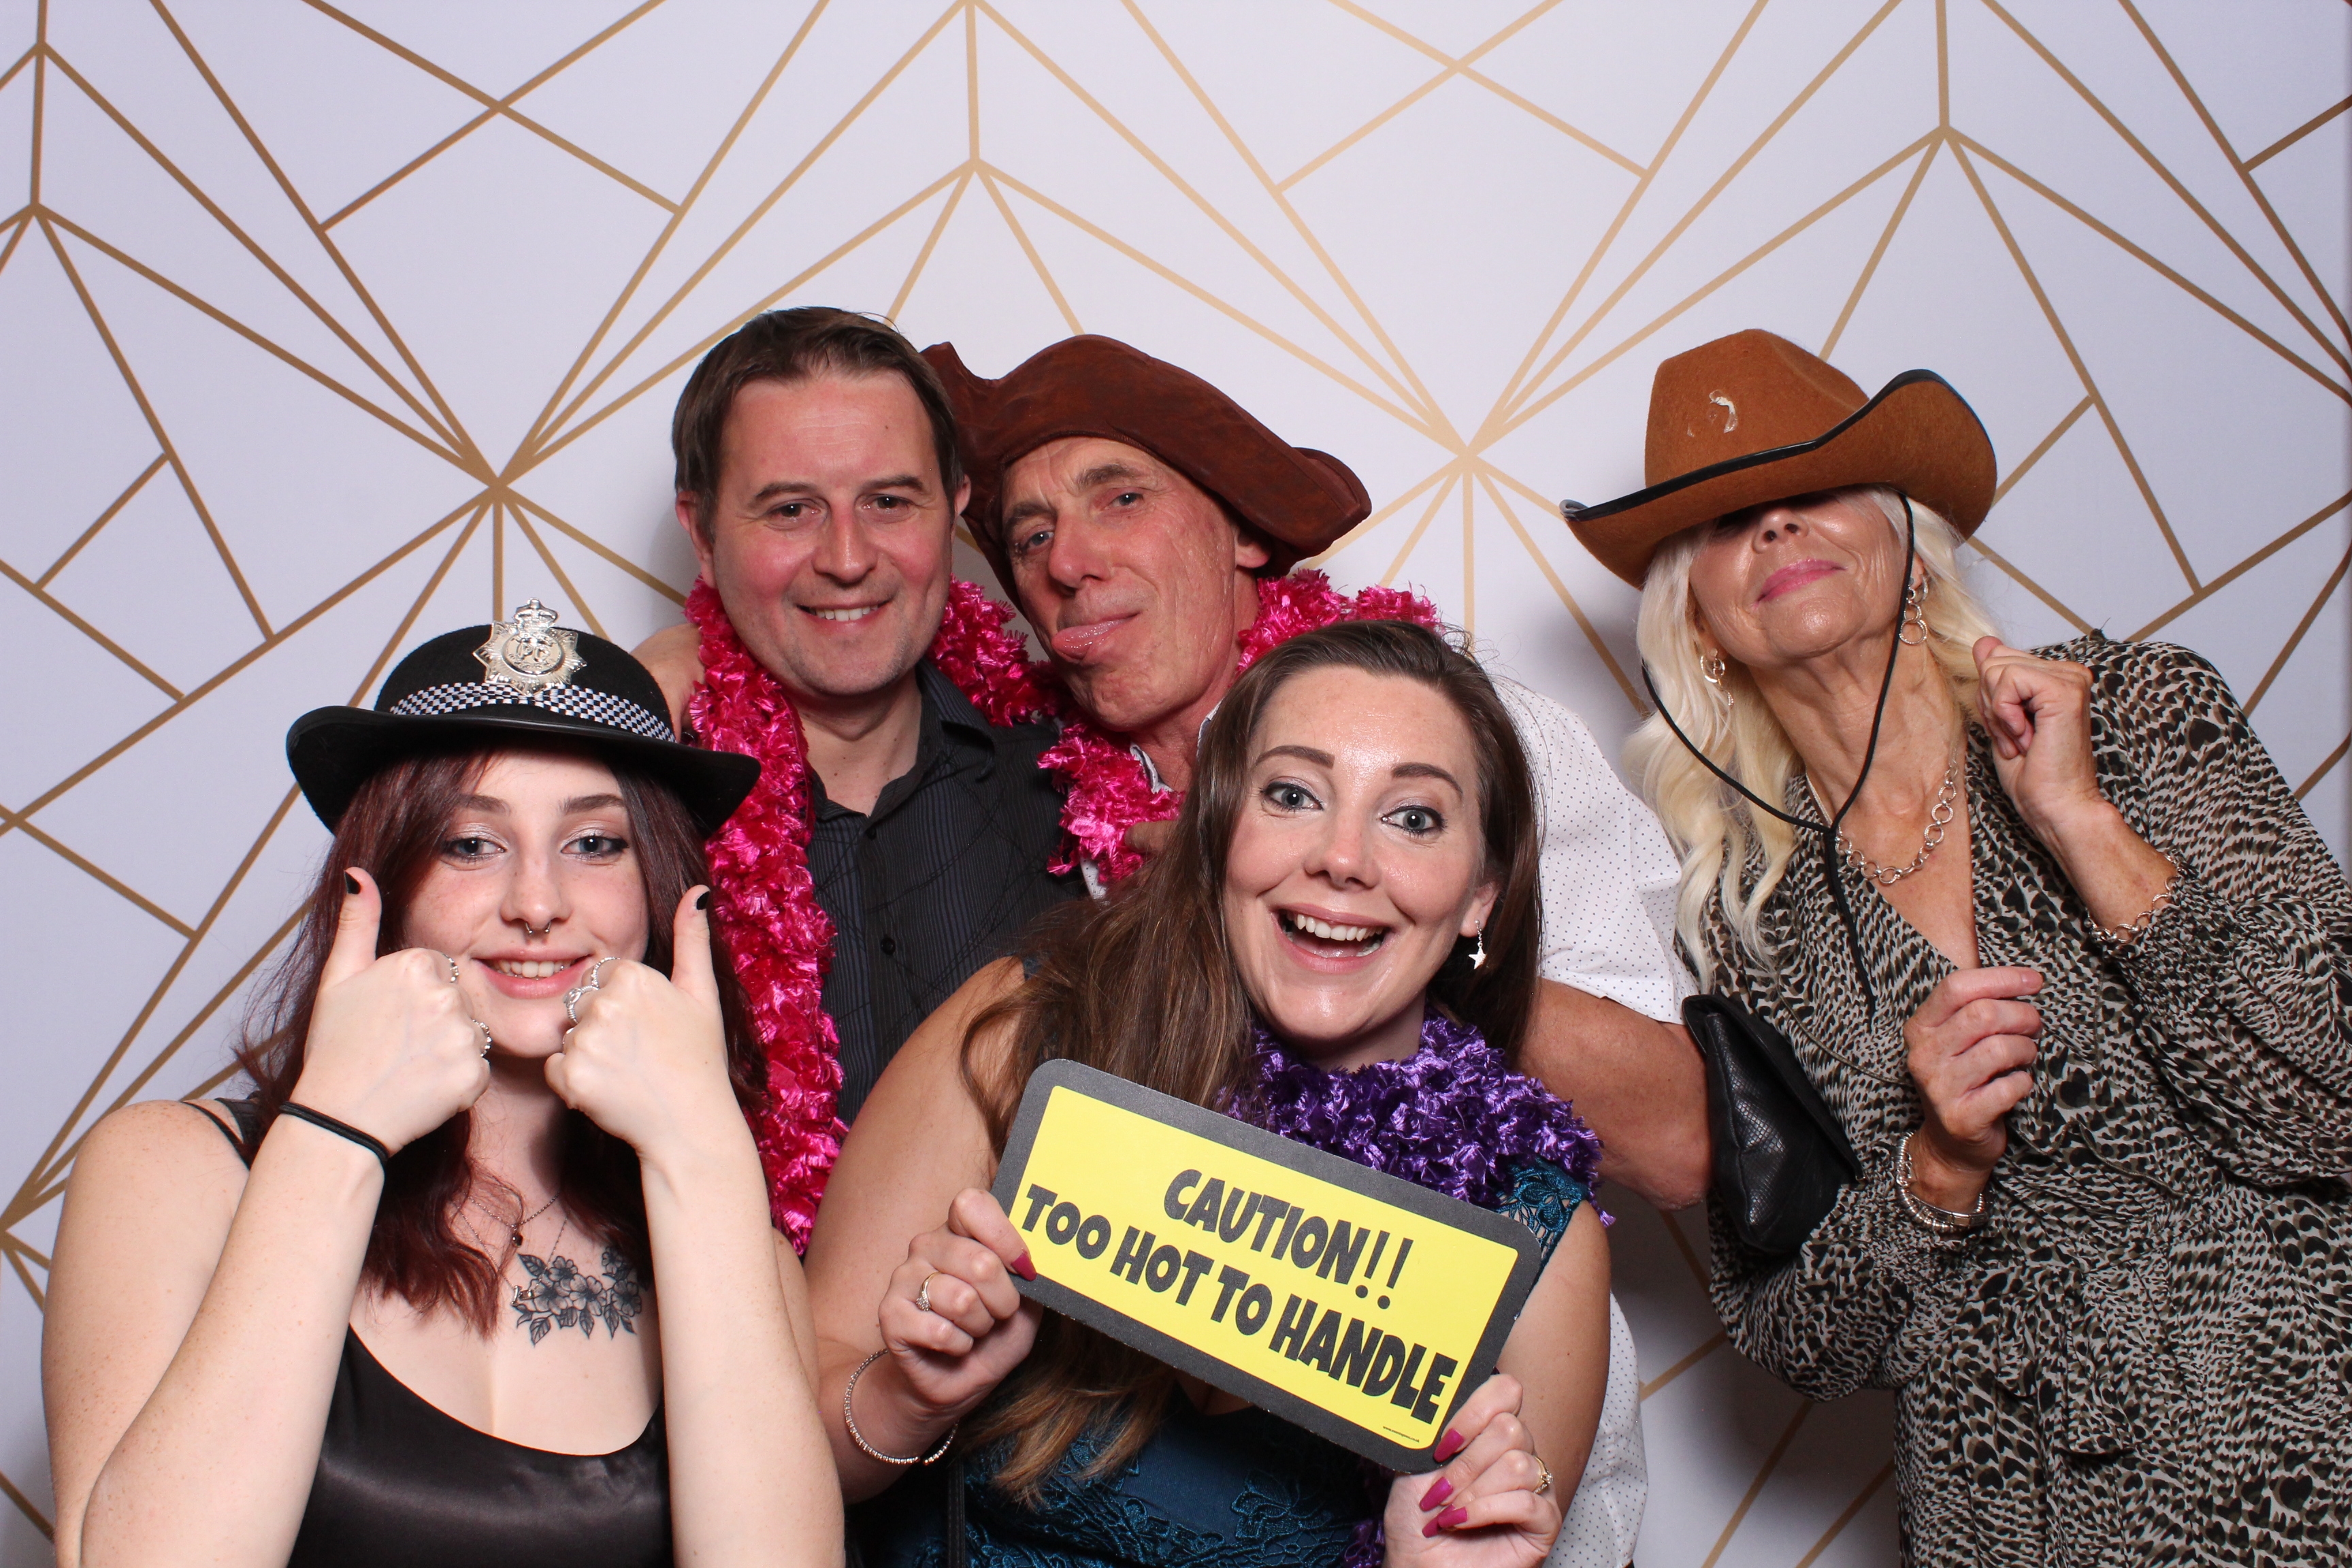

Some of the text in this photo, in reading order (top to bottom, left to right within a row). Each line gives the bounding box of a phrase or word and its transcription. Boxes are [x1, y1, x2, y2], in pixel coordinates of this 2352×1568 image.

[1022, 1184, 1458, 1425] TOO HOT TO HANDLE
[1164, 1170, 1413, 1309] CAUTION!!
